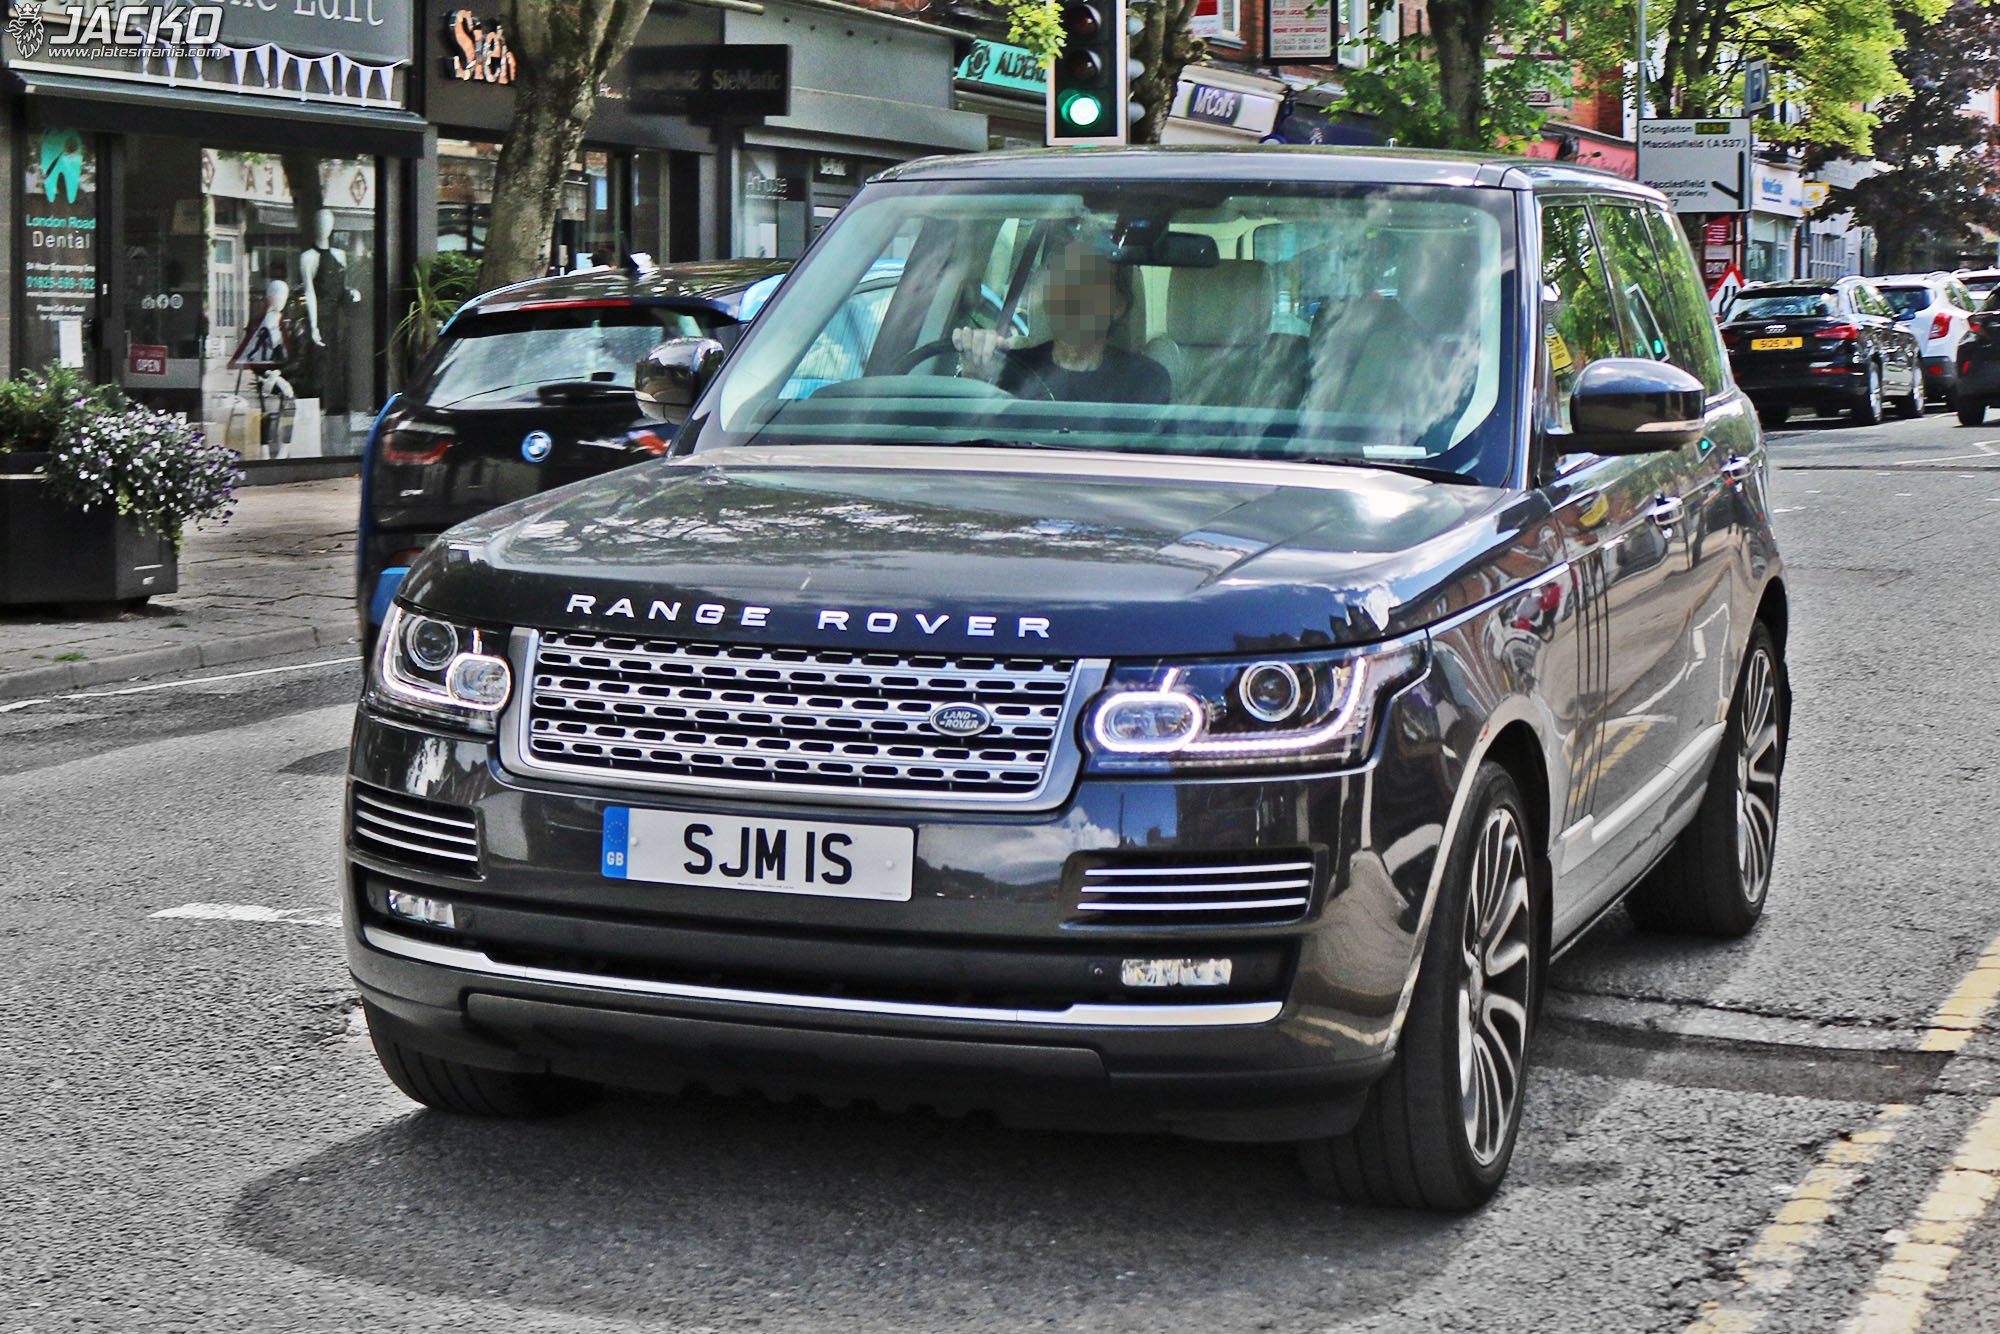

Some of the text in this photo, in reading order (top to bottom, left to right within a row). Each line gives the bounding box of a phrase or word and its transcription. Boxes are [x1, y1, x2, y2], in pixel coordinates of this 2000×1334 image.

[1641, 124, 1693, 135] Congleton
[1641, 140, 1704, 149] Macclesfield
[26, 213, 97, 230] London Road
[33, 230, 91, 248] Dental
[136, 358, 161, 373] OPEN
[566, 594, 1050, 638] RANGE ROVER
[606, 852, 624, 866] GB
[683, 823, 787, 881] SJM
